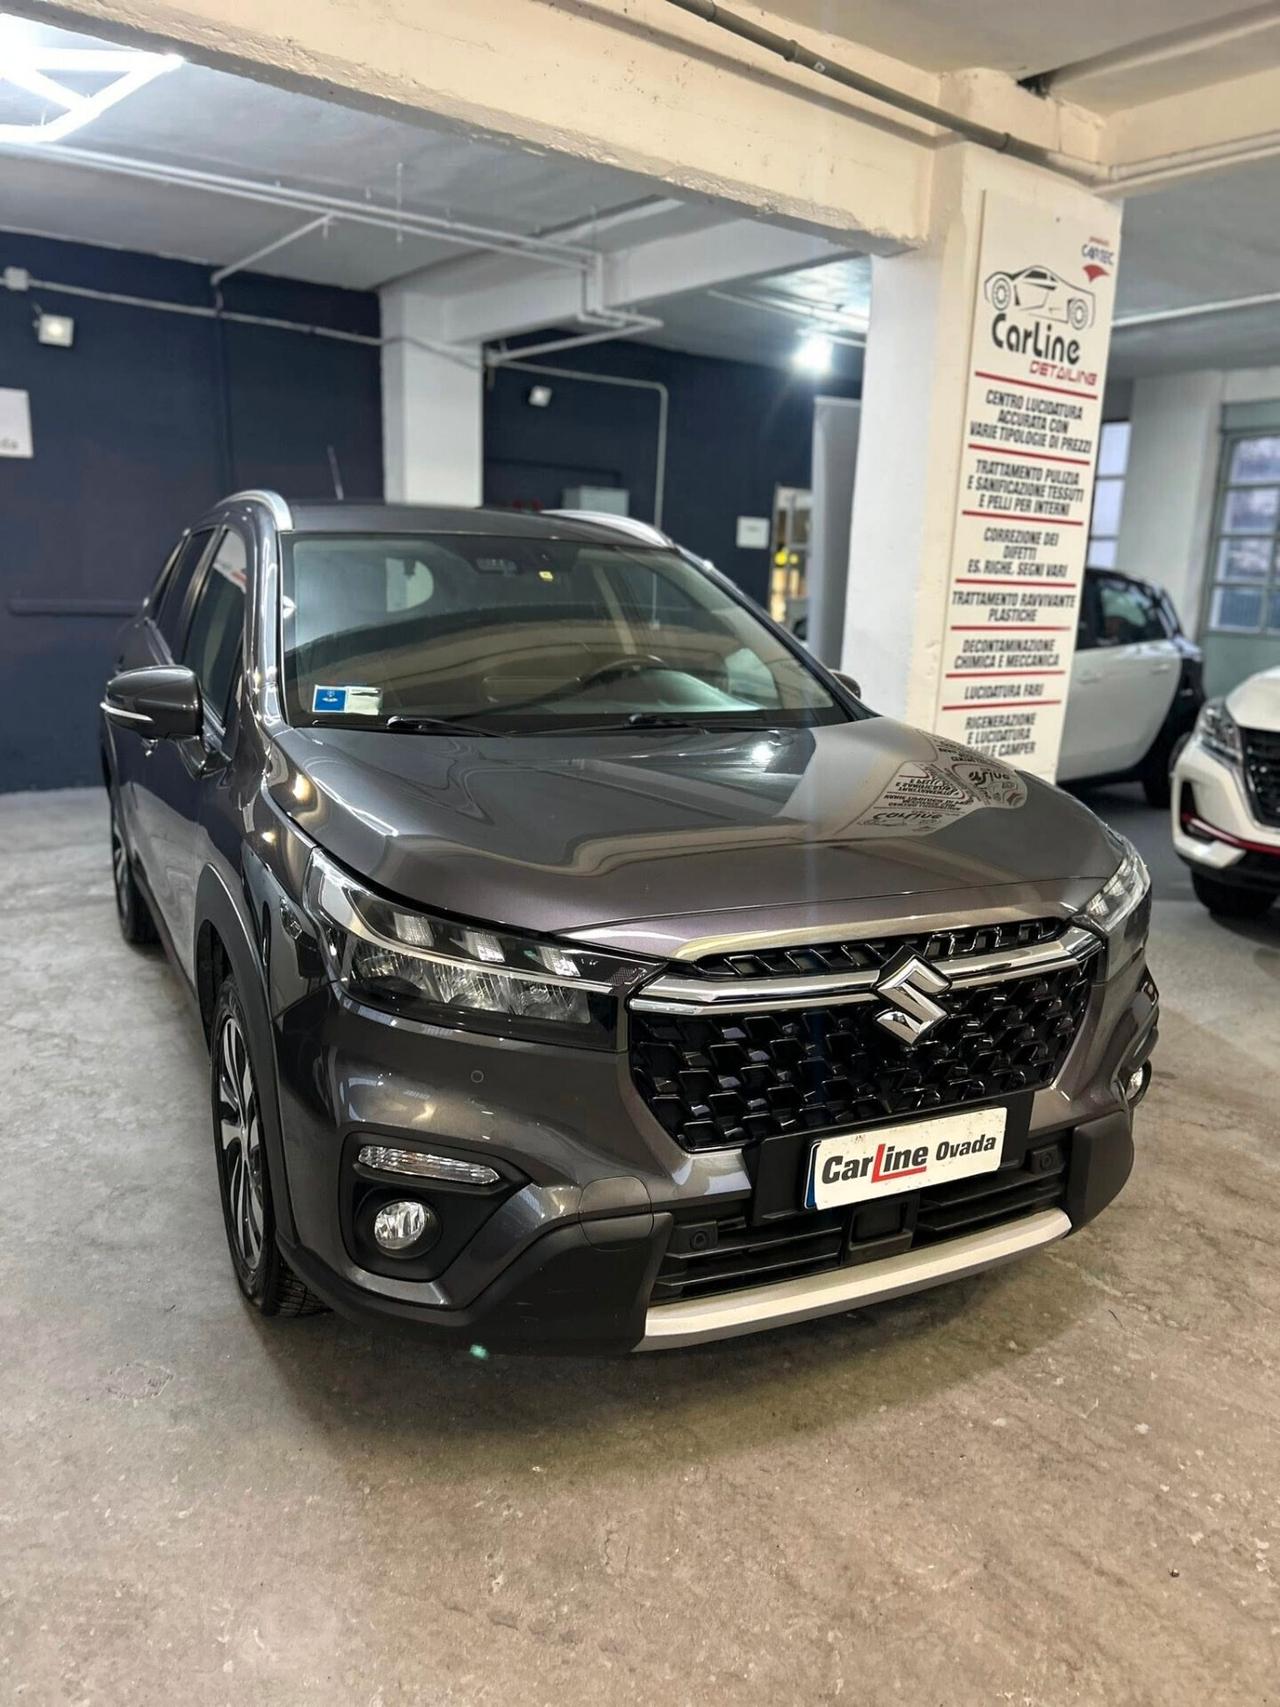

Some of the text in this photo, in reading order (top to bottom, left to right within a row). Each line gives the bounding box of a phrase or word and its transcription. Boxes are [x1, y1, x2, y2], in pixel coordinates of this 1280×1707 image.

[991, 313, 1080, 365] CarLine
[1029, 360, 1097, 386] DETAILING
[985, 389, 1082, 420] CENTRO LUCIDATURA
[997, 409, 1069, 434] ACCURATA CON
[970, 421, 1092, 454] VARIE TIPOLOGIE DI PREZZI
[976, 459, 1080, 485] TRATTAMENTO PULIZIA
[967, 475, 1084, 502] E SANIFICAZIONE TESSUTI
[979, 493, 1070, 517] E PELLI PER INTERNI
[983, 527, 1060, 547] CORREZIONE DEI
[1003, 545, 1038, 561] DIFETTI
[1016, 562, 1045, 577] SEGNI
[1046, 563, 1068, 578] VARI
[952, 590, 1076, 608] TRATTAMENTO RAVVIVANTE
[988, 608, 1038, 622] PLASTICHE
[962, 638, 1056, 653] DECONTAMINAZIONE
[954, 653, 1060, 669] CHIMICA E MECCANICA
[964, 683, 1044, 700] LUCIDATURA FARI
[965, 712, 1037, 730] RIGENERAZIONE
[967, 727, 1031, 745] E LUCIDATURA
[990, 744, 997, 758] E
[998, 741, 1037, 757] CAMPER
[822, 1134, 997, 1184] CarLine Ovada
